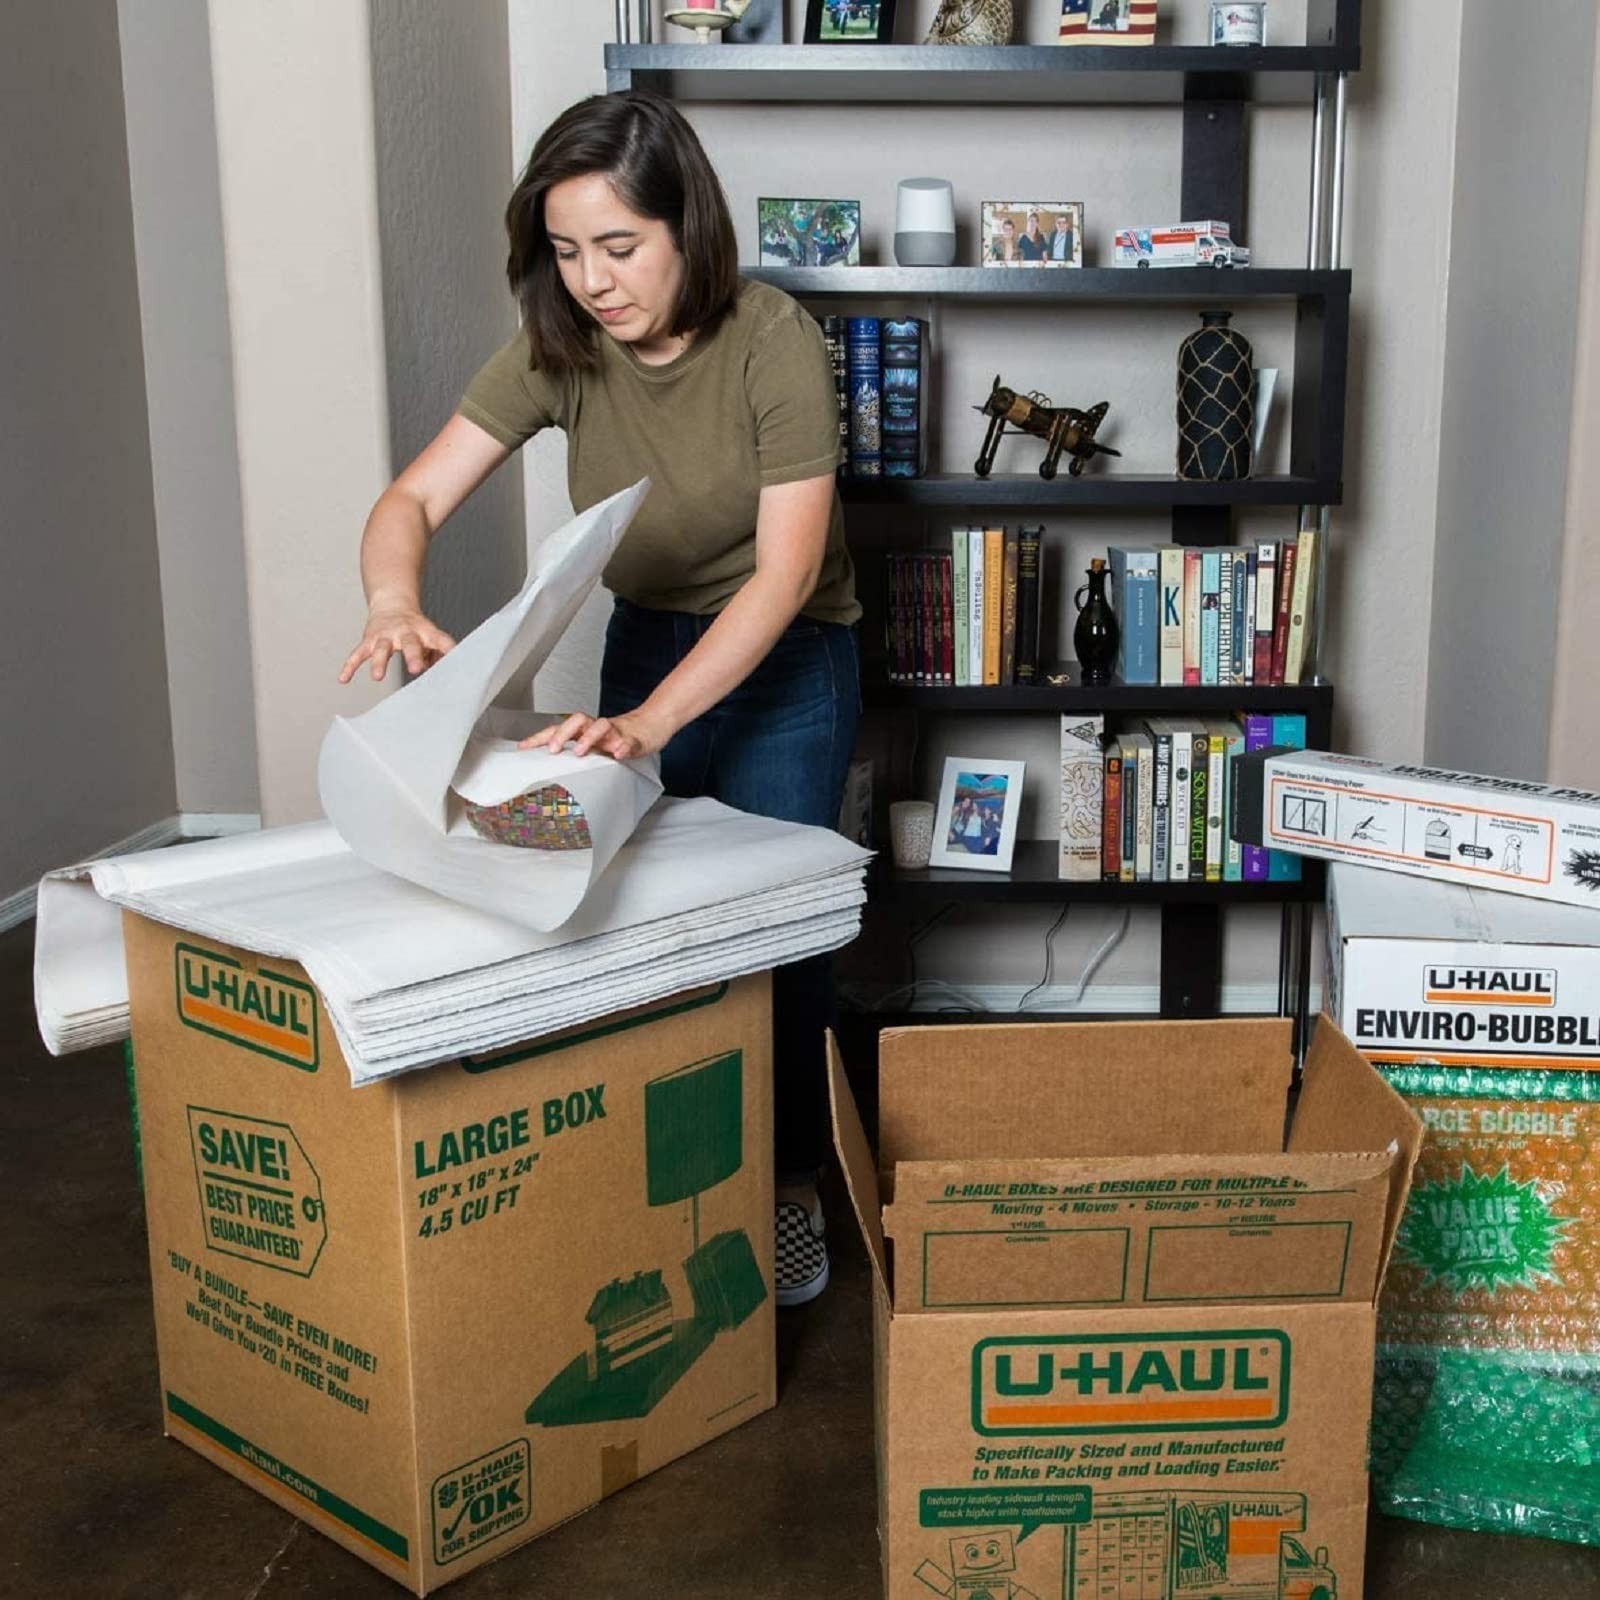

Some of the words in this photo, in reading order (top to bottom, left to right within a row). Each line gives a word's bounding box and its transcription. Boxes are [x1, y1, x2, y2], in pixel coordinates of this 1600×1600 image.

[1164, 586, 1180, 626] K
[1156, 765, 1168, 806] SUMMERS
[1193, 771, 1206, 800] SON
[1392, 765, 1549, 792] WRAPPING
[1177, 785, 1186, 830] WICKED
[1191, 817, 1205, 861] WITCH
[1429, 970, 1551, 993] U-HAUL
[1356, 1008, 1600, 1047] ENVIRO-BUBBL
[415, 1108, 530, 1179] LARGE
[543, 1084, 607, 1137] BOX
[1480, 1109, 1577, 1136] BUBBLE
[199, 1122, 290, 1181] SAVE!
[418, 1183, 448, 1208] 18"
[451, 1183, 462, 1198] x
[467, 1168, 495, 1192] 18"
[499, 1166, 509, 1181] x
[513, 1153, 540, 1177] 24"
[1099, 1179, 1177, 1194] DESIGNED
[1181, 1179, 1211, 1191] FOR
[1216, 1176, 1289, 1190] MULTIPLE
[205, 1184, 243, 1216] BEST
[248, 1195, 295, 1229] PRICE
[418, 1209, 454, 1239] 4.5
[461, 1196, 488, 1226] CU
[494, 1184, 520, 1214] FT
[991, 1202, 1043, 1215] Moving
[1059, 1203, 1067, 1214] 4
[1073, 1202, 1118, 1213] Moves
[1145, 1200, 1199, 1212] Storage
[1216, 1199, 1251, 1209] 10-12
[1259, 1197, 1296, 1208] Years
[1430, 1196, 1521, 1229] VALUE
[1441, 1226, 1519, 1258] PACK
[194, 1264, 202, 1282] A
[297, 1319, 329, 1350] EVEN
[333, 1338, 377, 1374] MORE!
[199, 1288, 221, 1314] Beat
[224, 1303, 242, 1325] Our
[246, 1314, 283, 1348] Bundle
[286, 1337, 321, 1368] Prices
[326, 1361, 349, 1382] and
[186, 1300, 210, 1327] We'll
[213, 1317, 234, 1341] Give
[237, 1330, 256, 1353] You
[280, 1354, 291, 1373] in
[295, 1362, 324, 1391] FREE
[328, 1379, 370, 1414] Boxes!
[995, 1347, 1268, 1396] U-HAUL
[973, 1467, 989, 1480] to
[994, 1466, 1040, 1480] Make
[1046, 1465, 1112, 1480] Packing
[1118, 1462, 1150, 1476] and
[1155, 1460, 1220, 1477] Loading
[975, 1445, 1075, 1463] Specifically
[1080, 1443, 1126, 1458] Sized
[1130, 1442, 1162, 1457] and
[1168, 1438, 1285, 1455] Manufactured
[240, 1442, 318, 1501] uhaul.com
[462, 1460, 524, 1499] BOXES
[469, 1477, 523, 1524] OK
[927, 1495, 966, 1507] Industry
[968, 1495, 1002, 1505] leading
[1004, 1493, 1043, 1503] sidewall
[938, 1509, 964, 1518] stack
[966, 1508, 995, 1519] higher
[998, 1507, 1020, 1517] with
[1232, 1504, 1283, 1517] U-HAUL
[441, 1538, 465, 1558] FOR
[469, 1507, 524, 1543] SHIPPING
